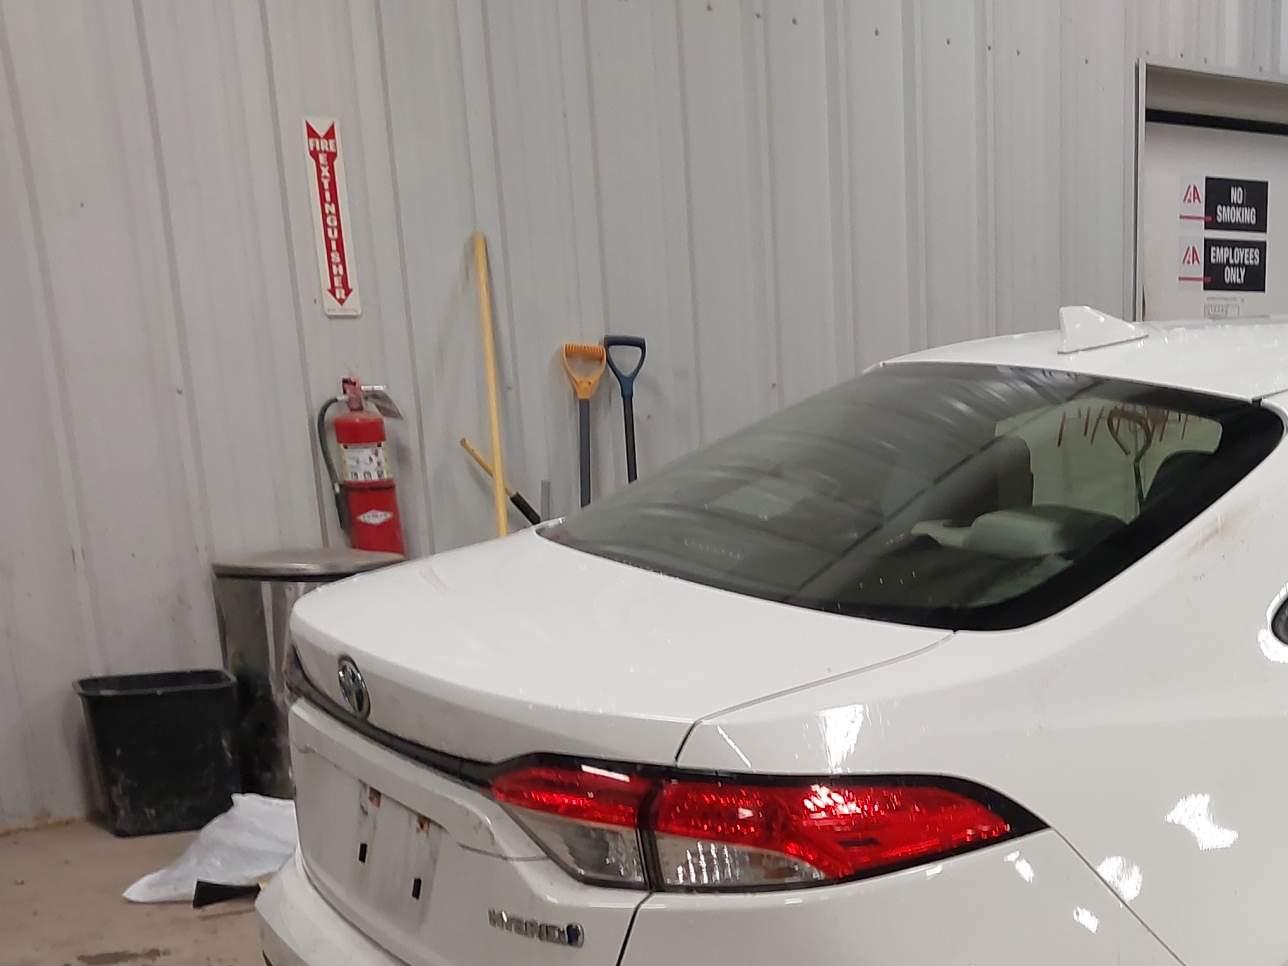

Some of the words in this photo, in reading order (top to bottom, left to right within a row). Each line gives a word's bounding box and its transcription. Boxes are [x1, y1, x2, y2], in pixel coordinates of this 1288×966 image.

[308, 138, 338, 153] FIRE
[1230, 185, 1244, 205] NO
[1216, 204, 1257, 225] SMOKING
[318, 152, 346, 300] EXTINGUISHER
[1210, 246, 1260, 266] EMPLOYEES
[1224, 266, 1246, 285] ONLY
